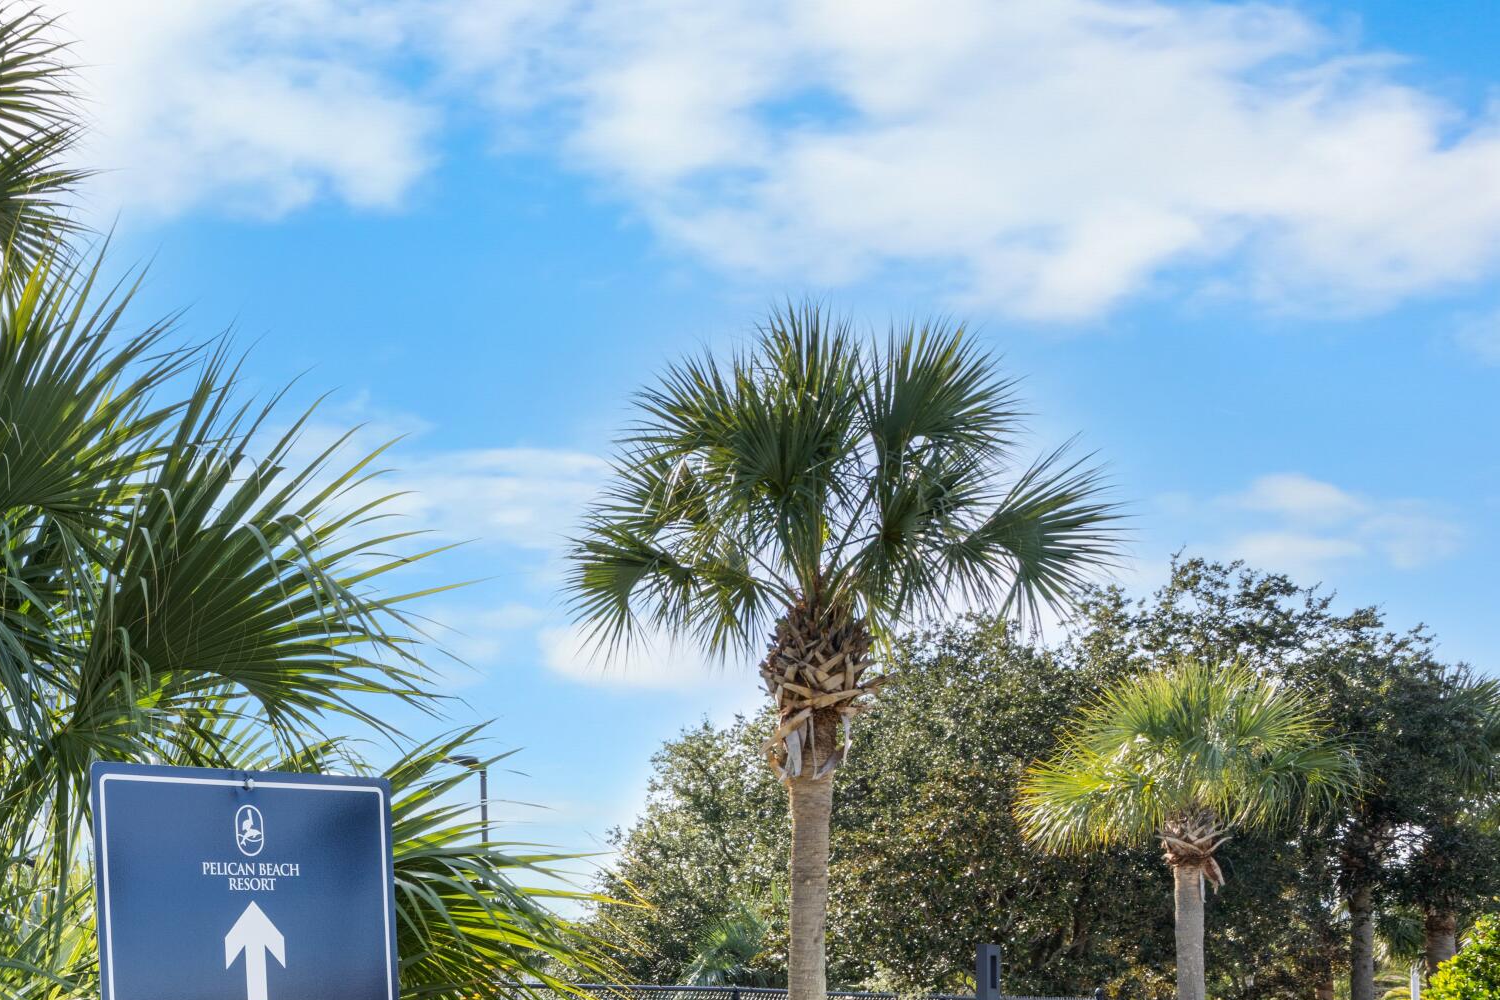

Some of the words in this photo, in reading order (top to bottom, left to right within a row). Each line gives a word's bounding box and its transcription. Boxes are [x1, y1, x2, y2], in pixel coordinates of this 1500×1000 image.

[202, 862, 255, 876] PELICAN
[259, 862, 300, 877] BEACH
[228, 878, 276, 891] RESORT
